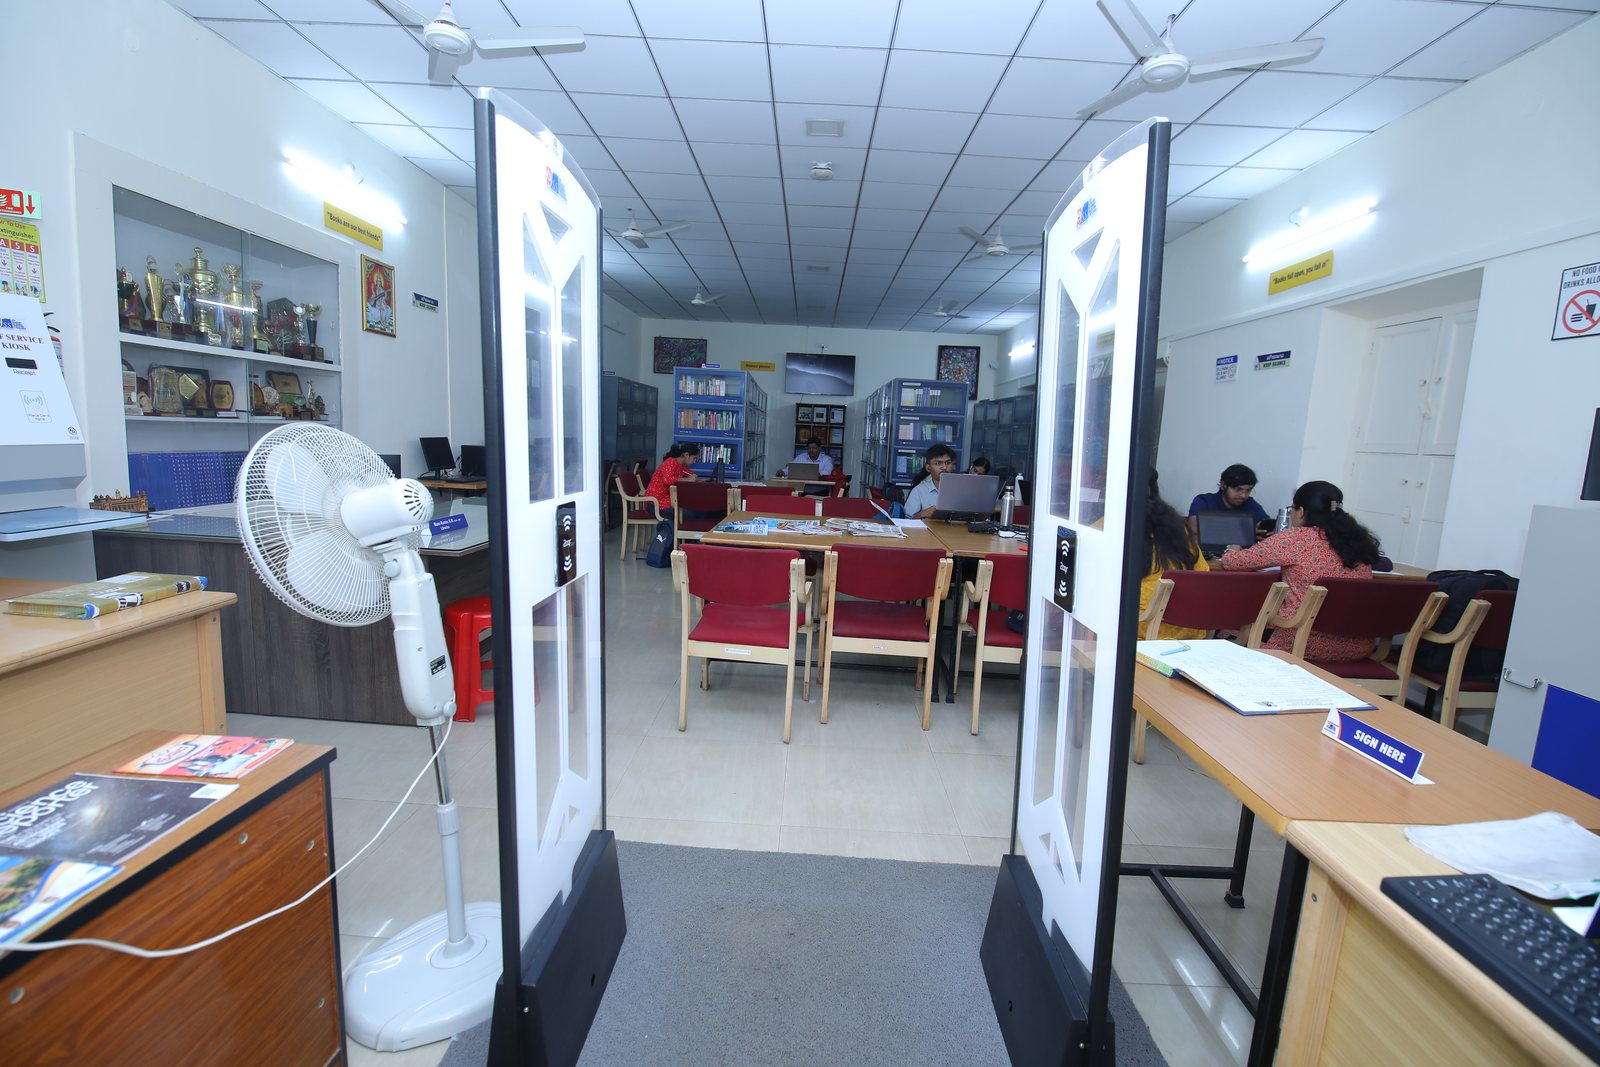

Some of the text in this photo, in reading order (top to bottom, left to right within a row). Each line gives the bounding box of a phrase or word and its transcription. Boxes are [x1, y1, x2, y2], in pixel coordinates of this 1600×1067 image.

[0, 228, 34, 239] xtinguisher
[15, 242, 21, 250] S
[29, 245, 36, 253] S
[1572, 269, 1581, 277] NO
[1582, 266, 1597, 275] FOOD
[1563, 275, 1600, 289] DRINKS ALLO
[5, 333, 45, 344] SERVICE
[1, 341, 31, 351] KIOSK
[1353, 729, 1407, 764] SIGN HERE
